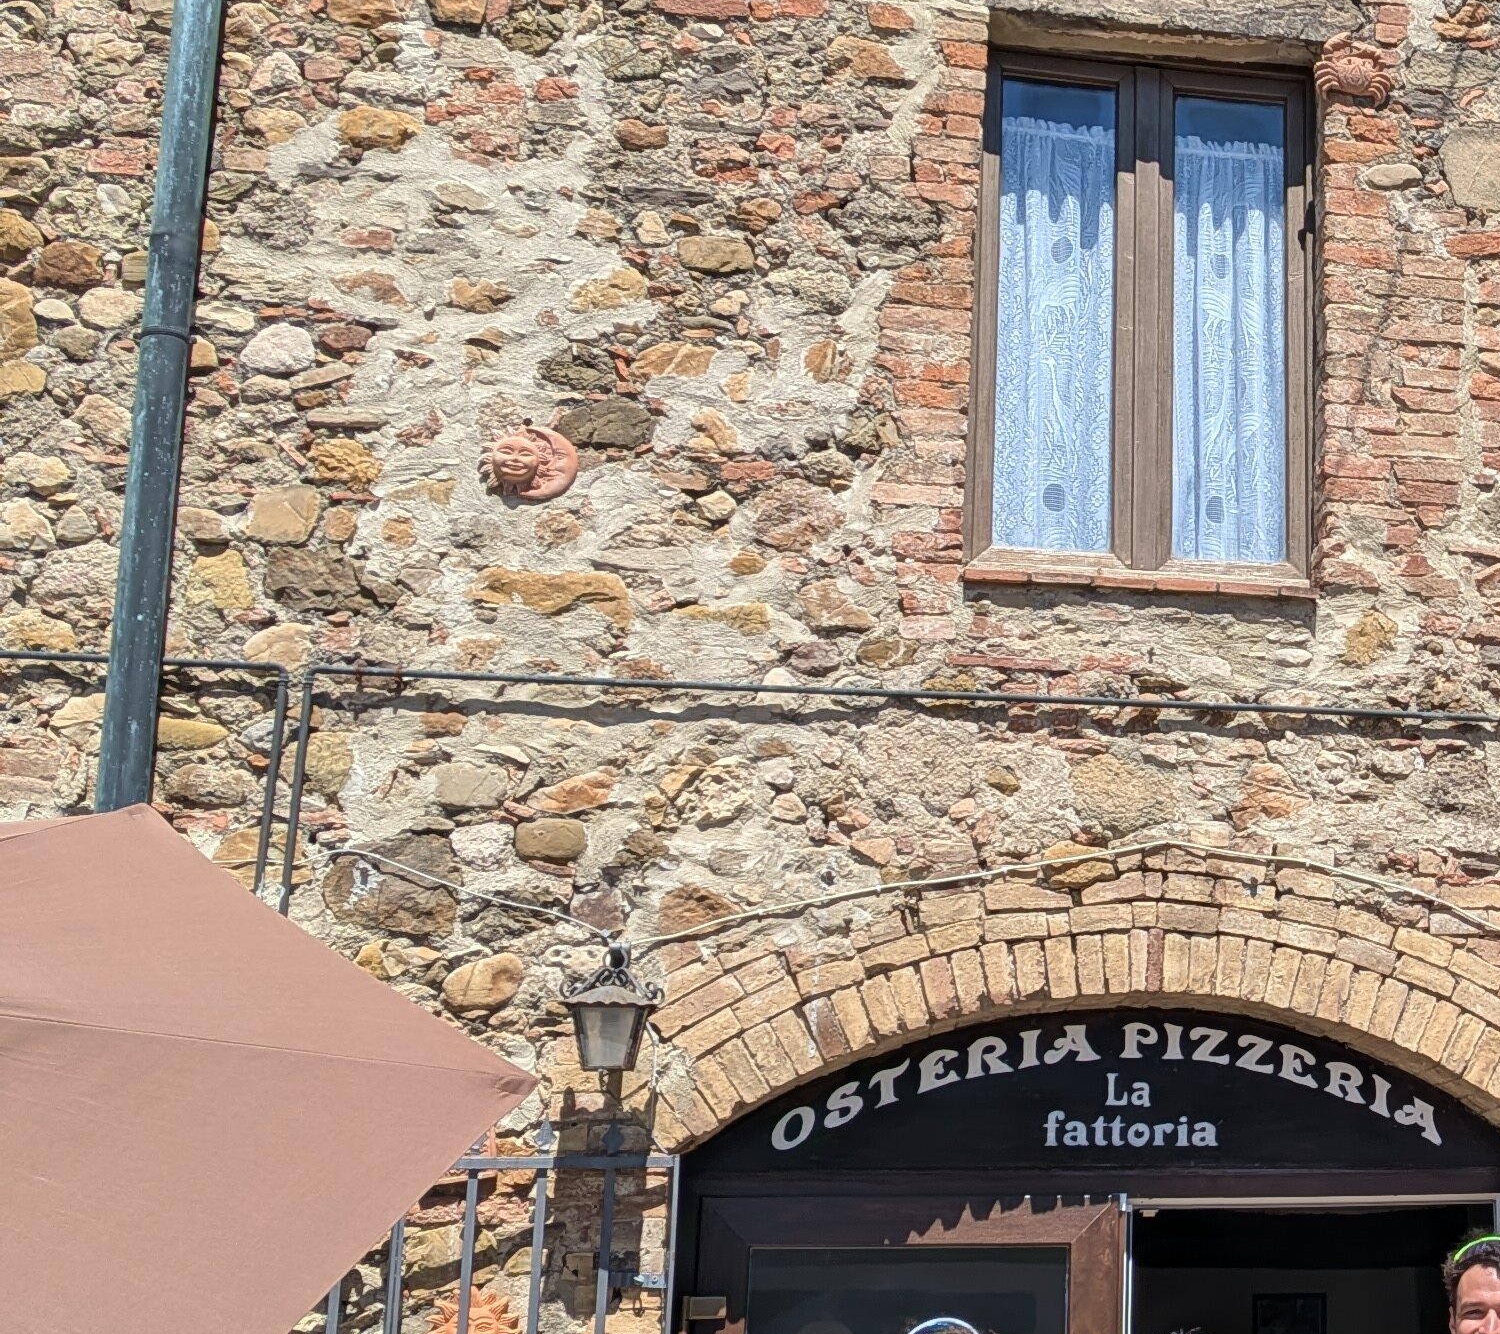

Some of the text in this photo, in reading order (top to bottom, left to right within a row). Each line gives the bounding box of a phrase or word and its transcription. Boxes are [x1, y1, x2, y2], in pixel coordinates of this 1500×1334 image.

[771, 1021, 1443, 1151] OSTERIA PIZZERIA
[1104, 1072, 1152, 1108] La
[1043, 1110, 1219, 1148] fattoria
